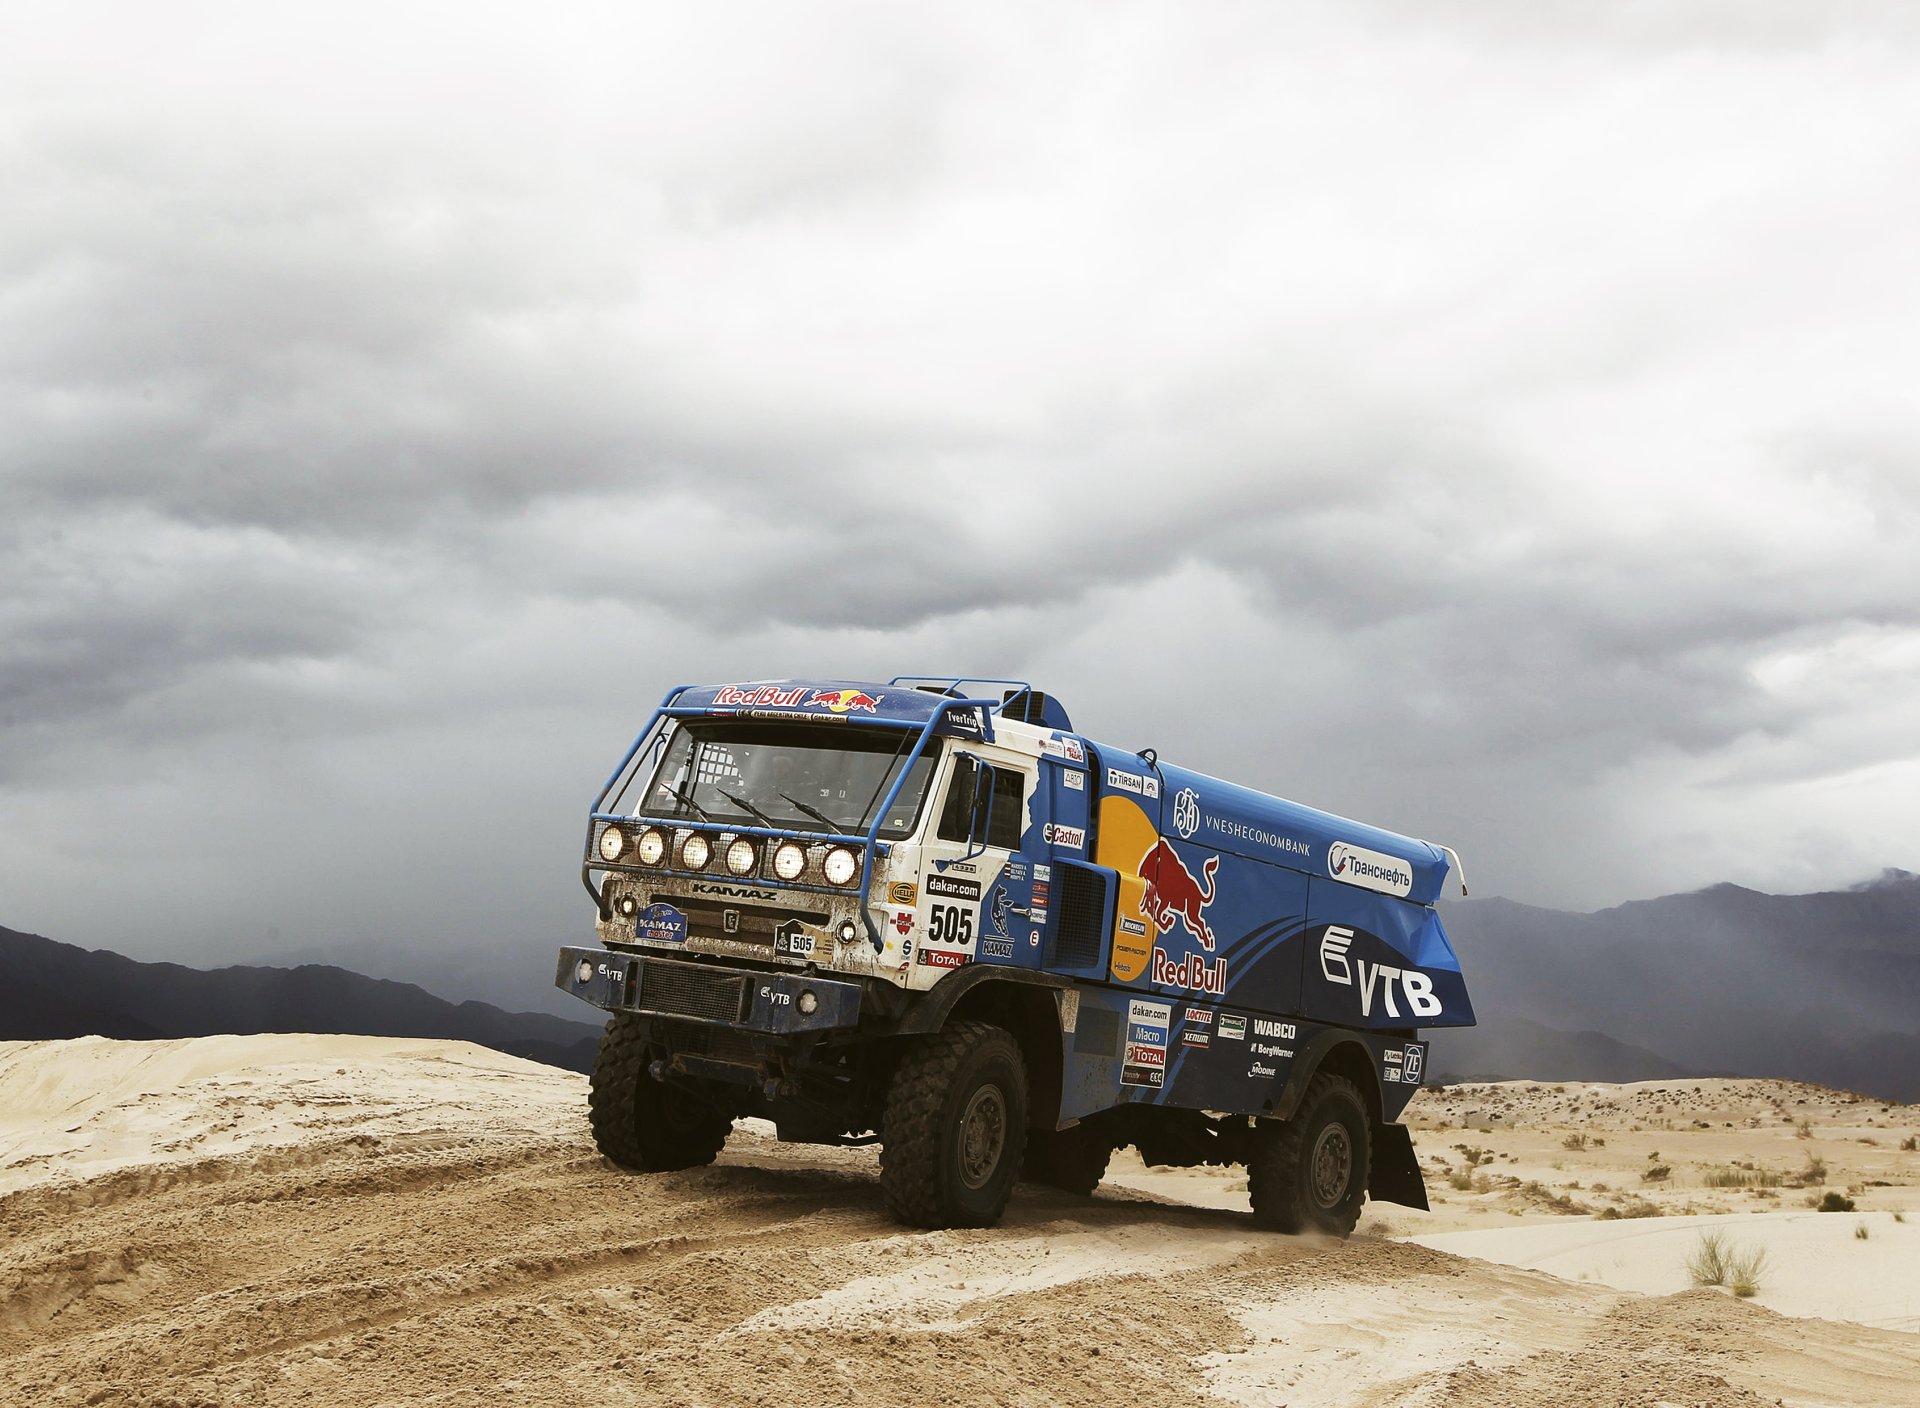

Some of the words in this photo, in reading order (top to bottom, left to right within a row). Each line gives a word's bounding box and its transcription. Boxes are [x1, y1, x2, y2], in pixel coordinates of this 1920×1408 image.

[712, 686, 762, 705] Red
[755, 686, 810, 707] Bull
[813, 713, 846, 722] dakar.com
[946, 710, 977, 728] TverTrip
[1053, 827, 1082, 847] Castrol
[1205, 815, 1311, 857] VNESHECONOMBANK
[1348, 855, 1410, 887] Транснефть
[692, 883, 778, 901] KAMAZ
[894, 888, 914, 898] HELLA
[929, 877, 978, 897] dakar.com
[640, 918, 682, 932] KAMAZ
[928, 903, 974, 945] 505
[646, 929, 674, 940] master
[793, 936, 812, 951] 505
[982, 940, 1014, 958] KAMAZ
[930, 951, 962, 966] TOTAL
[606, 968, 623, 982] VTB
[1151, 946, 1191, 988] Red
[1190, 953, 1228, 995] Bull
[1357, 959, 1443, 1018] VTB
[770, 992, 790, 1006] VTB
[1132, 1004, 1167, 1020] dakar.com
[1185, 1008, 1212, 1022] LOCTITE
[1135, 1026, 1160, 1042] Macro
[1254, 1019, 1296, 1040] WABCO
[1135, 1048, 1164, 1064] TOTAL
[1258, 1043, 1294, 1059] BorgWarner
[1251, 1065, 1276, 1076] MODINE
[1407, 1053, 1420, 1075] ZF
